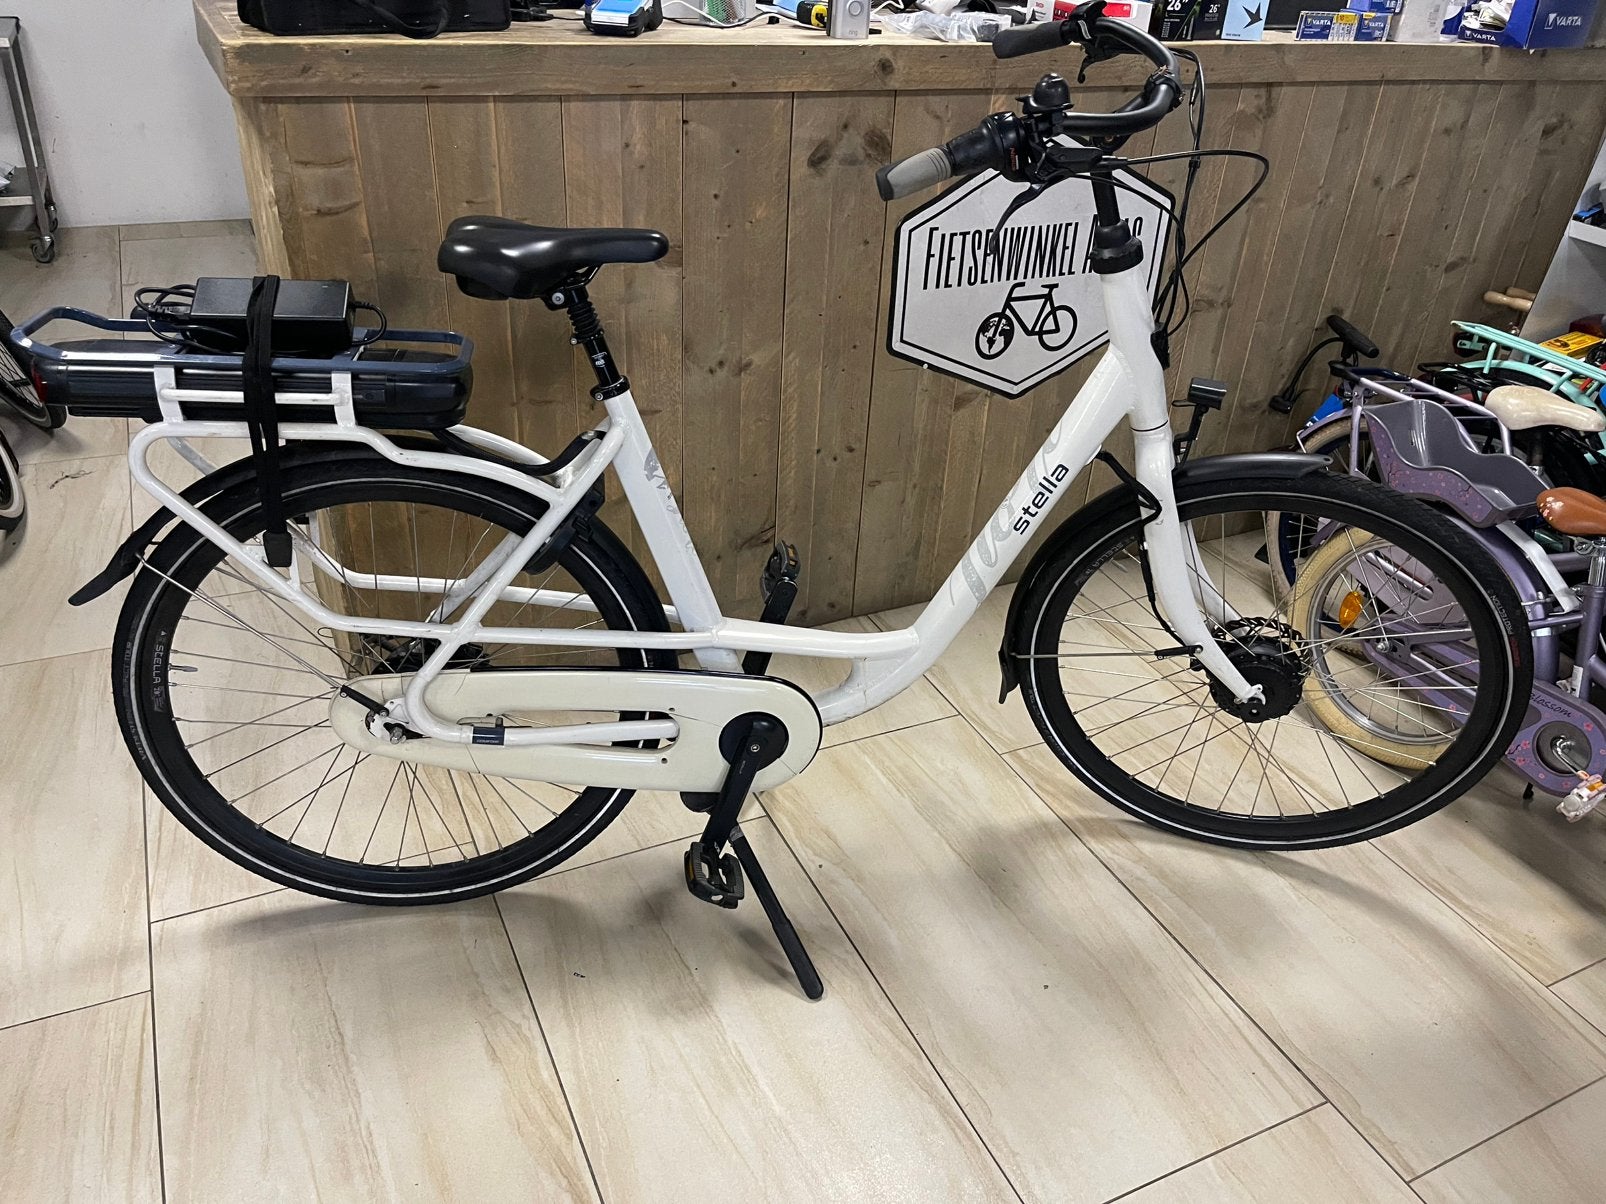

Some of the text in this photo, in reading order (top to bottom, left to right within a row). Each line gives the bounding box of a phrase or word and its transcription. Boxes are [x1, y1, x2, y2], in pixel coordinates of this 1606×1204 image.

[1555, 15, 1582, 26] VARTA
[1472, 32, 1496, 41] VARTA
[922, 221, 1080, 290] FIETSENWINKEL
[1013, 463, 1070, 535] stella
[1531, 692, 1572, 718] lossom
